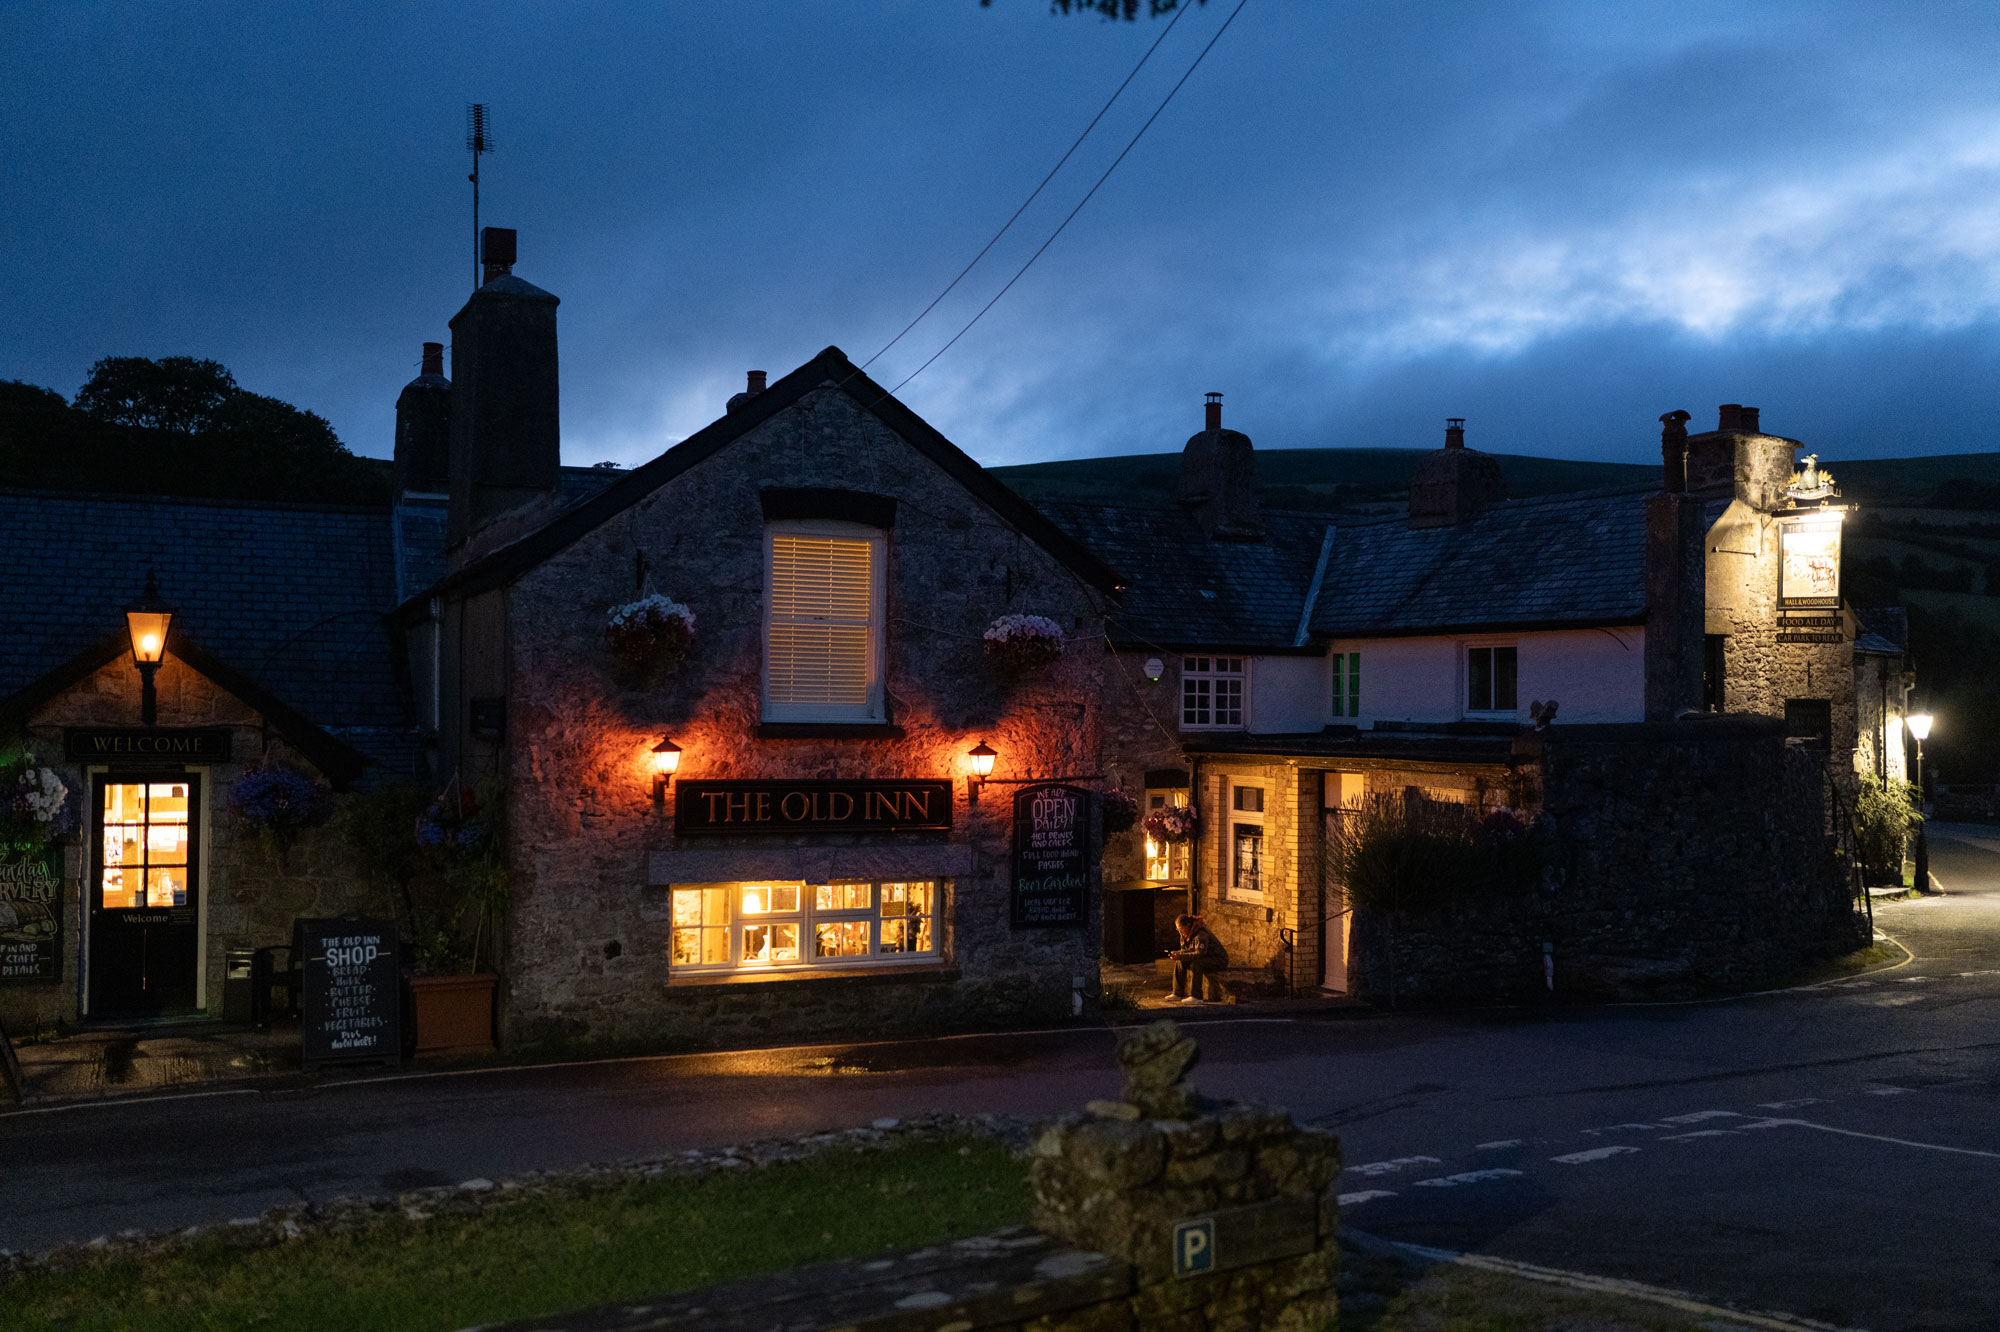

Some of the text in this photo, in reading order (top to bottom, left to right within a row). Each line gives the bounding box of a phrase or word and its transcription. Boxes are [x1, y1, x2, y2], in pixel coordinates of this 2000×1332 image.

[93, 736, 202, 753] WELCOME
[1036, 788, 1067, 798] WE ARE
[701, 791, 931, 823] THE OLD INN
[1032, 798, 1075, 819] OPEN
[1034, 815, 1074, 831] DAILY!
[1031, 831, 1074, 841] HOT DRINKS
[1032, 839, 1072, 848] AND CAKES
[1023, 851, 1040, 860] FULL
[1042, 850, 1059, 859] FOOD
[1018, 878, 1041, 892] Beer
[122, 914, 168, 923] Welcome
[321, 935, 380, 948] THE OLD INN
[326, 945, 377, 967] SHOP
[2, 963, 41, 977] DETAILS
[332, 966, 367, 977] BREAD
[336, 976, 361, 986] MILK
[330, 985, 373, 997] BUTTER
[331, 995, 371, 1008] CHEESE
[336, 1006, 366, 1018] FRUIT
[324, 1016, 383, 1031] VEGETABLES
[341, 1030, 361, 1039] PLUS
[1185, 1228, 1207, 1270] P
